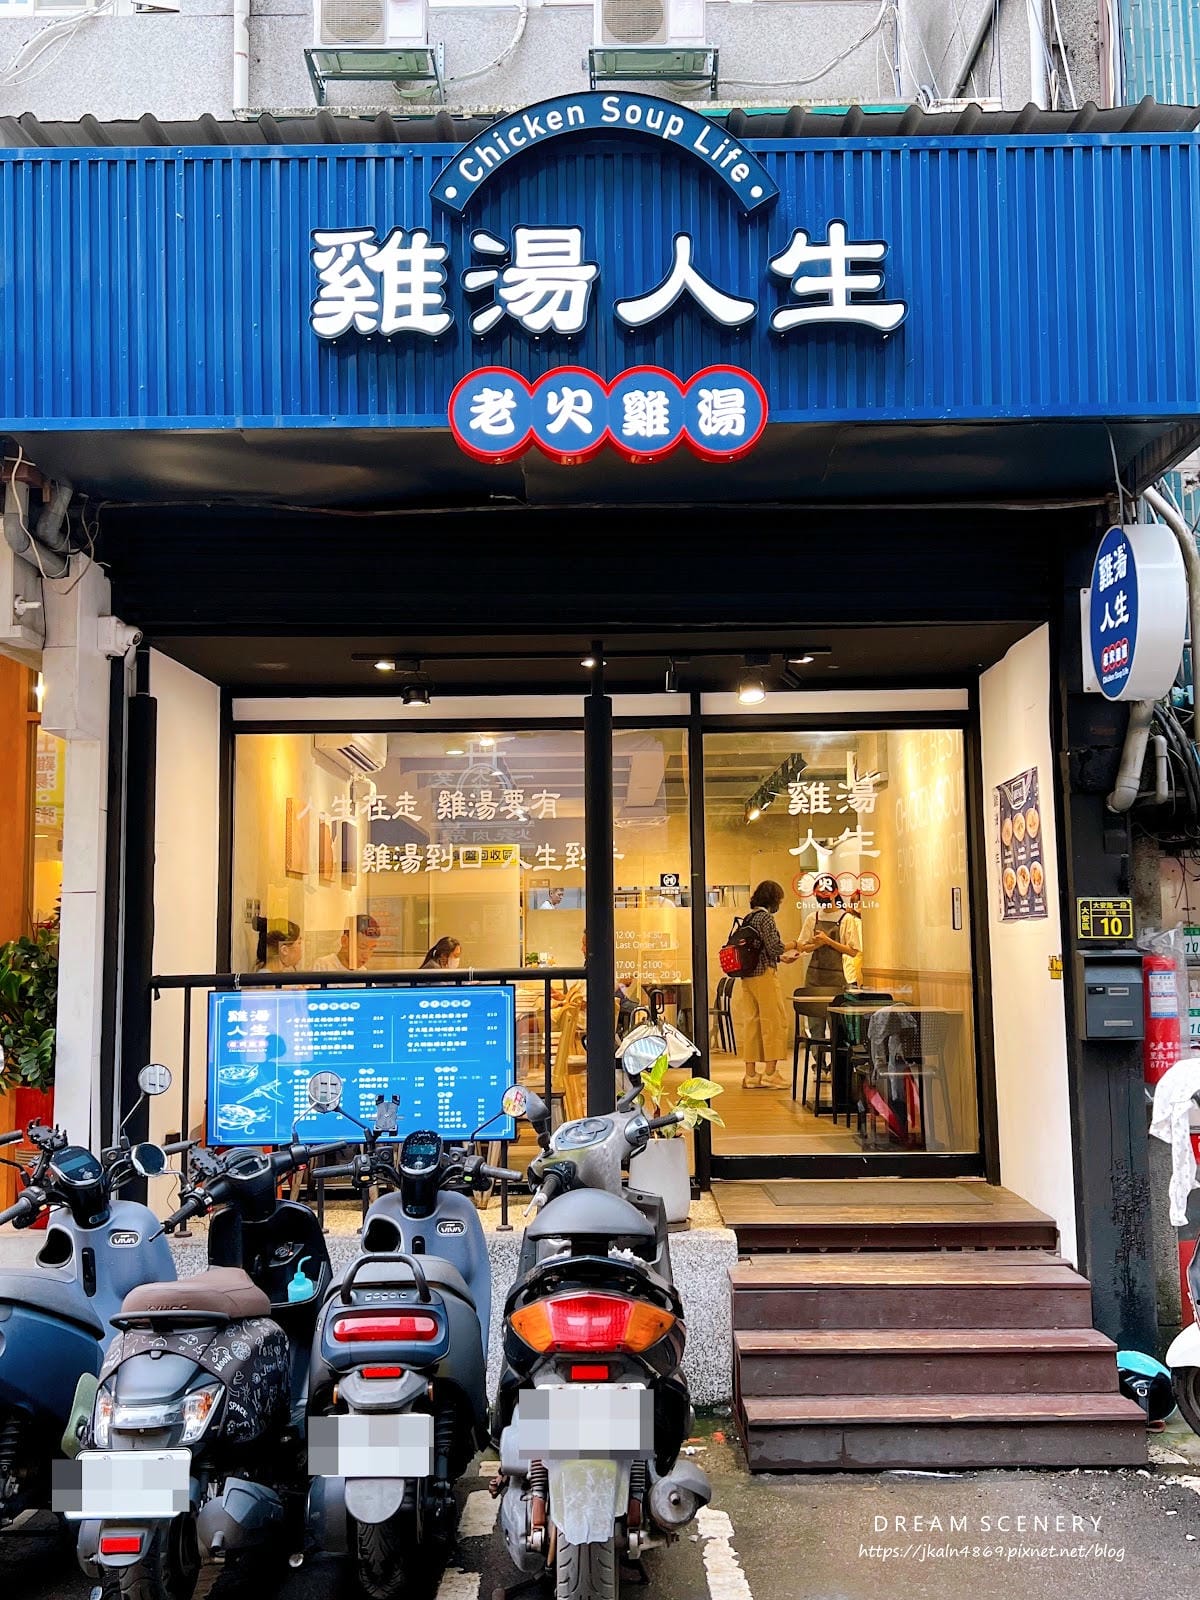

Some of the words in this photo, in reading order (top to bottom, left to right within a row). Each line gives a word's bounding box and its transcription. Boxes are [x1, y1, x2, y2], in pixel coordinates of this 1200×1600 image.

[458, 104, 585, 183] Chicken
[601, 96, 684, 139] Soup
[693, 125, 750, 183] Life
[312, 219, 906, 335] 雞湯人生
[468, 387, 747, 438] 老火雞湯
[1098, 543, 1127, 592] 雞湯
[1101, 590, 1130, 633] 人生
[297, 790, 422, 822] 人生在走
[437, 789, 561, 821] 雞湯要有
[788, 782, 879, 815] 雞湯
[361, 843, 482, 873] 雞湯到口
[502, 842, 624, 872] 人生到
[789, 825, 881, 857] 人生
[796, 901, 833, 909] Chicken
[836, 901, 860, 909] Soup
[862, 901, 880, 909] Life
[1100, 917, 1123, 936] 10
[615, 971, 631, 979] Last
[229, 1401, 248, 1418] SPACE
